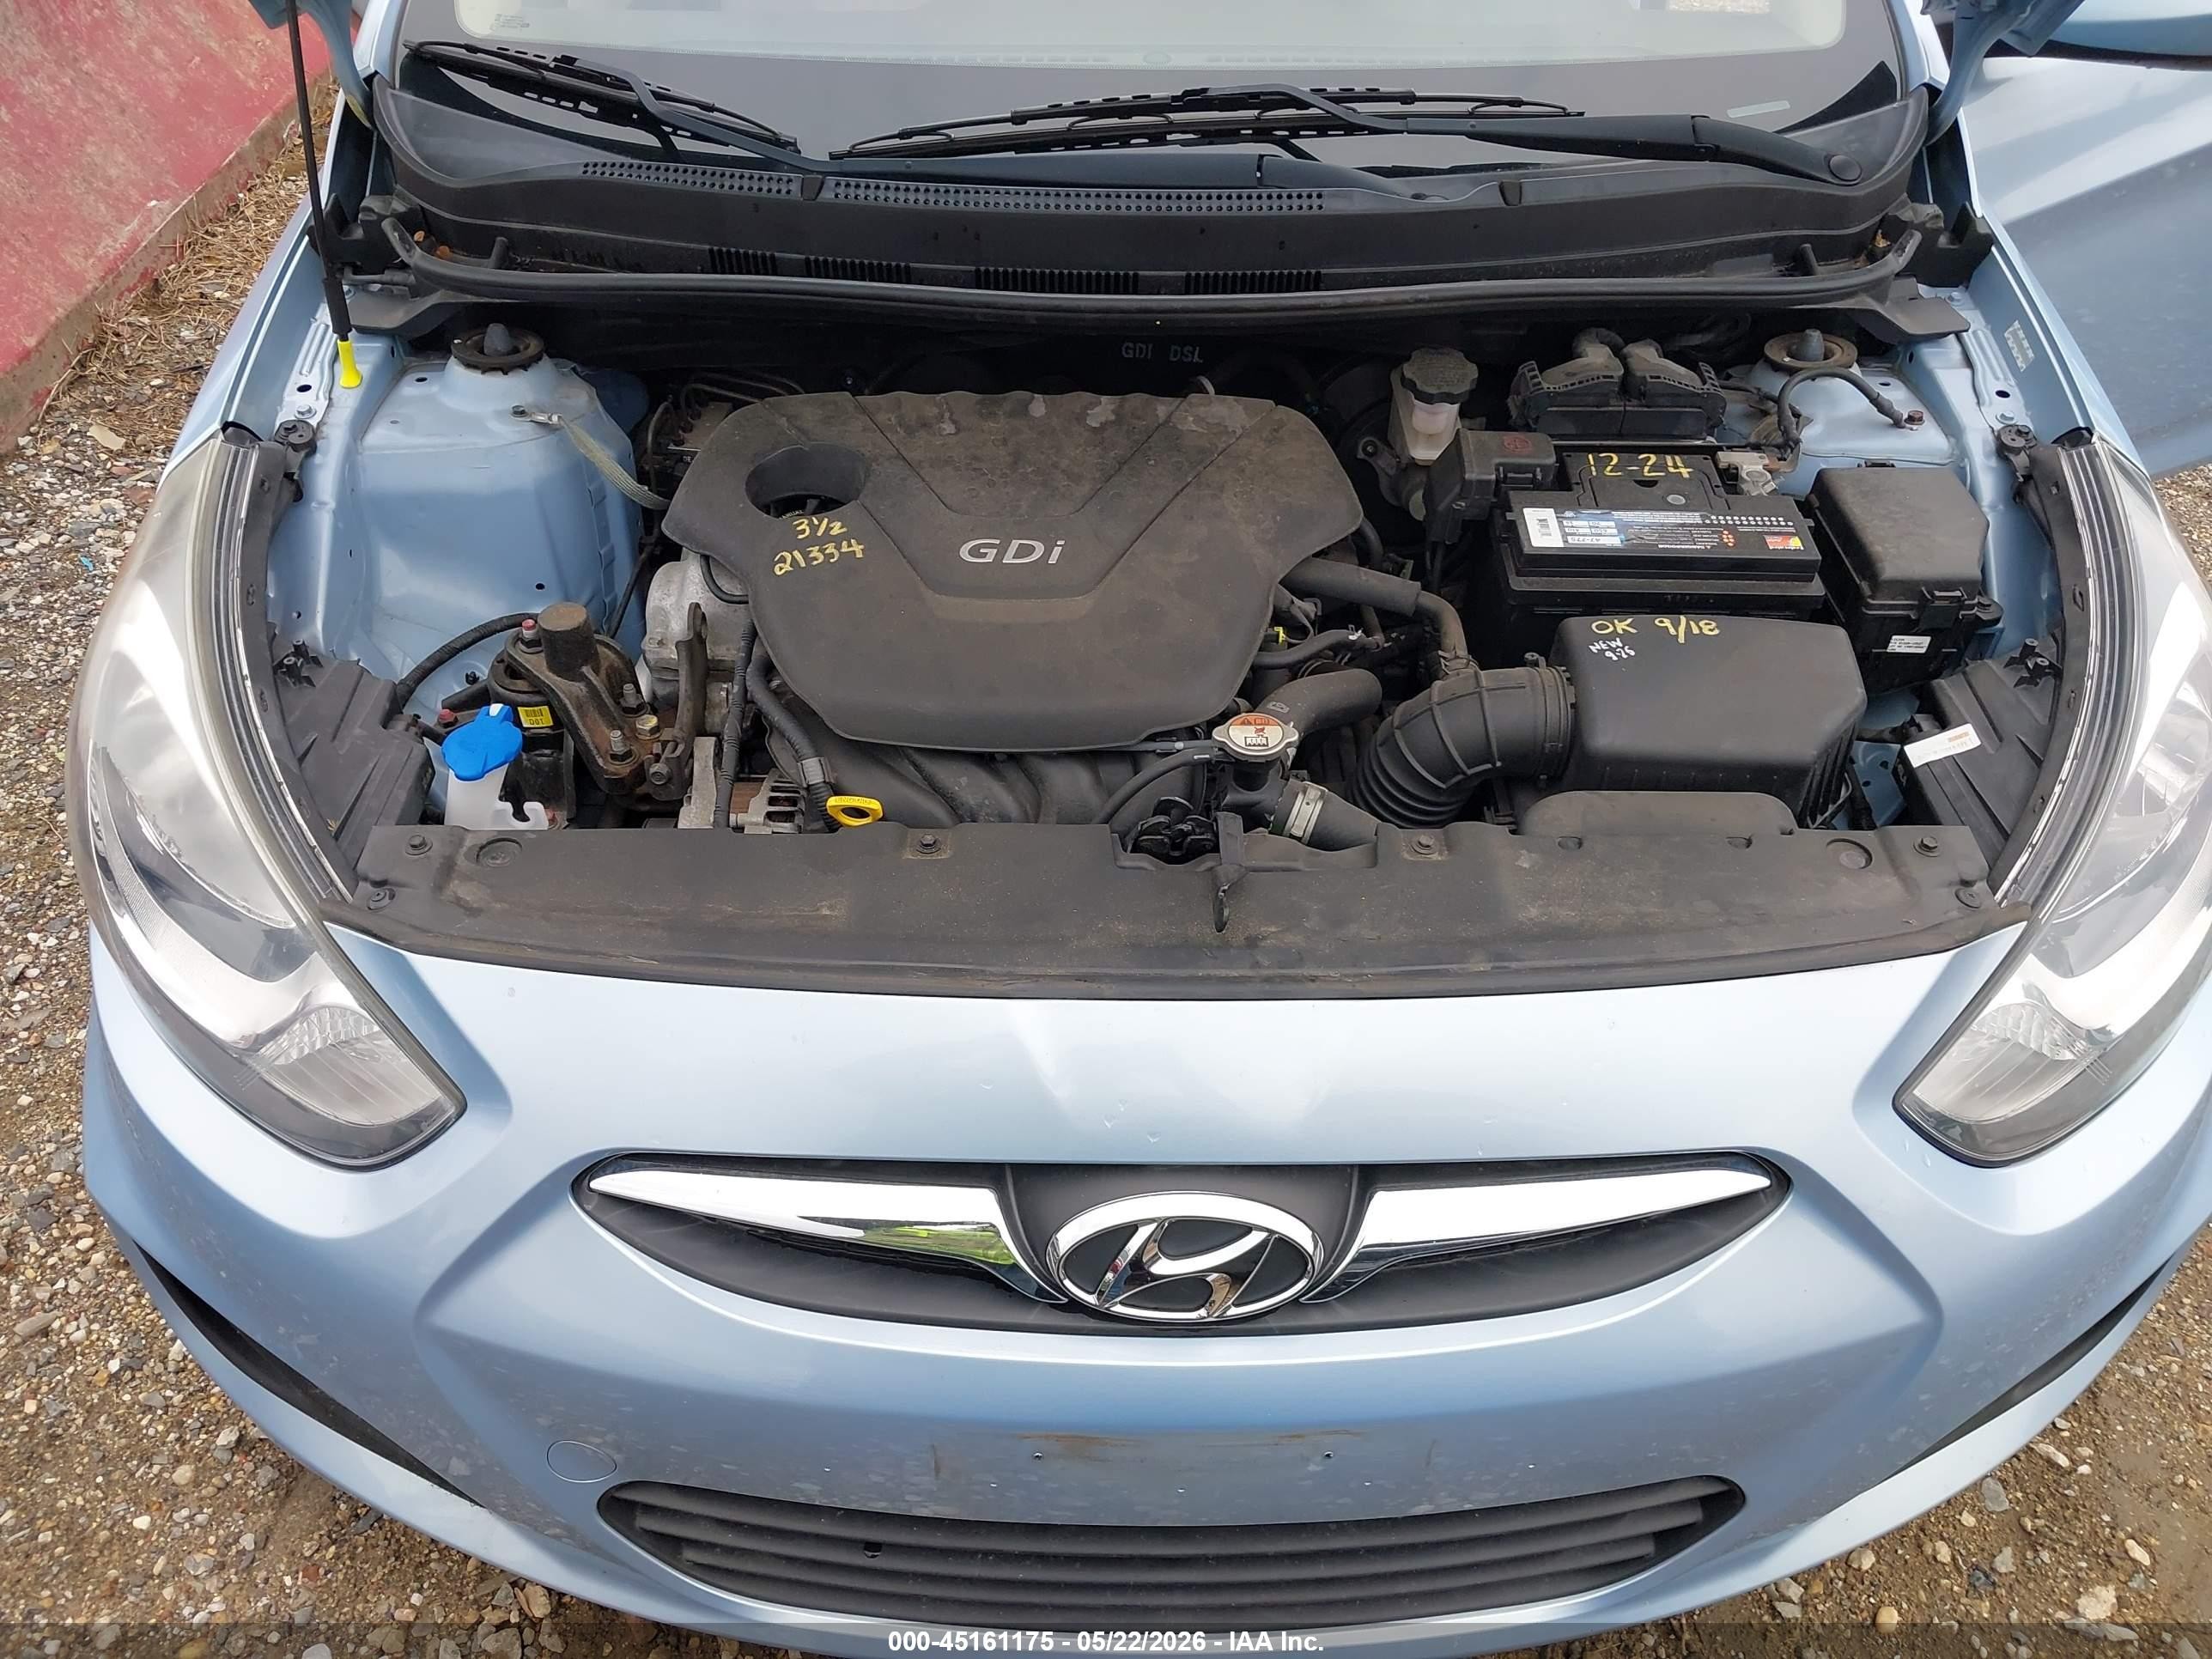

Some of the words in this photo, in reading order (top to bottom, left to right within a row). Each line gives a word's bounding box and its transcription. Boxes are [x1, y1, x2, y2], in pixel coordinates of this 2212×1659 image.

[1121, 342, 1152, 359] GDI
[1169, 345, 1203, 362] DSL
[1588, 453, 1693, 478] 12-24
[774, 538, 865, 575] 21334
[959, 538, 1065, 563] GDi
[1591, 617, 1638, 634] OK
[1654, 615, 1720, 643] 9/18
[1589, 637, 1624, 653] NEW
